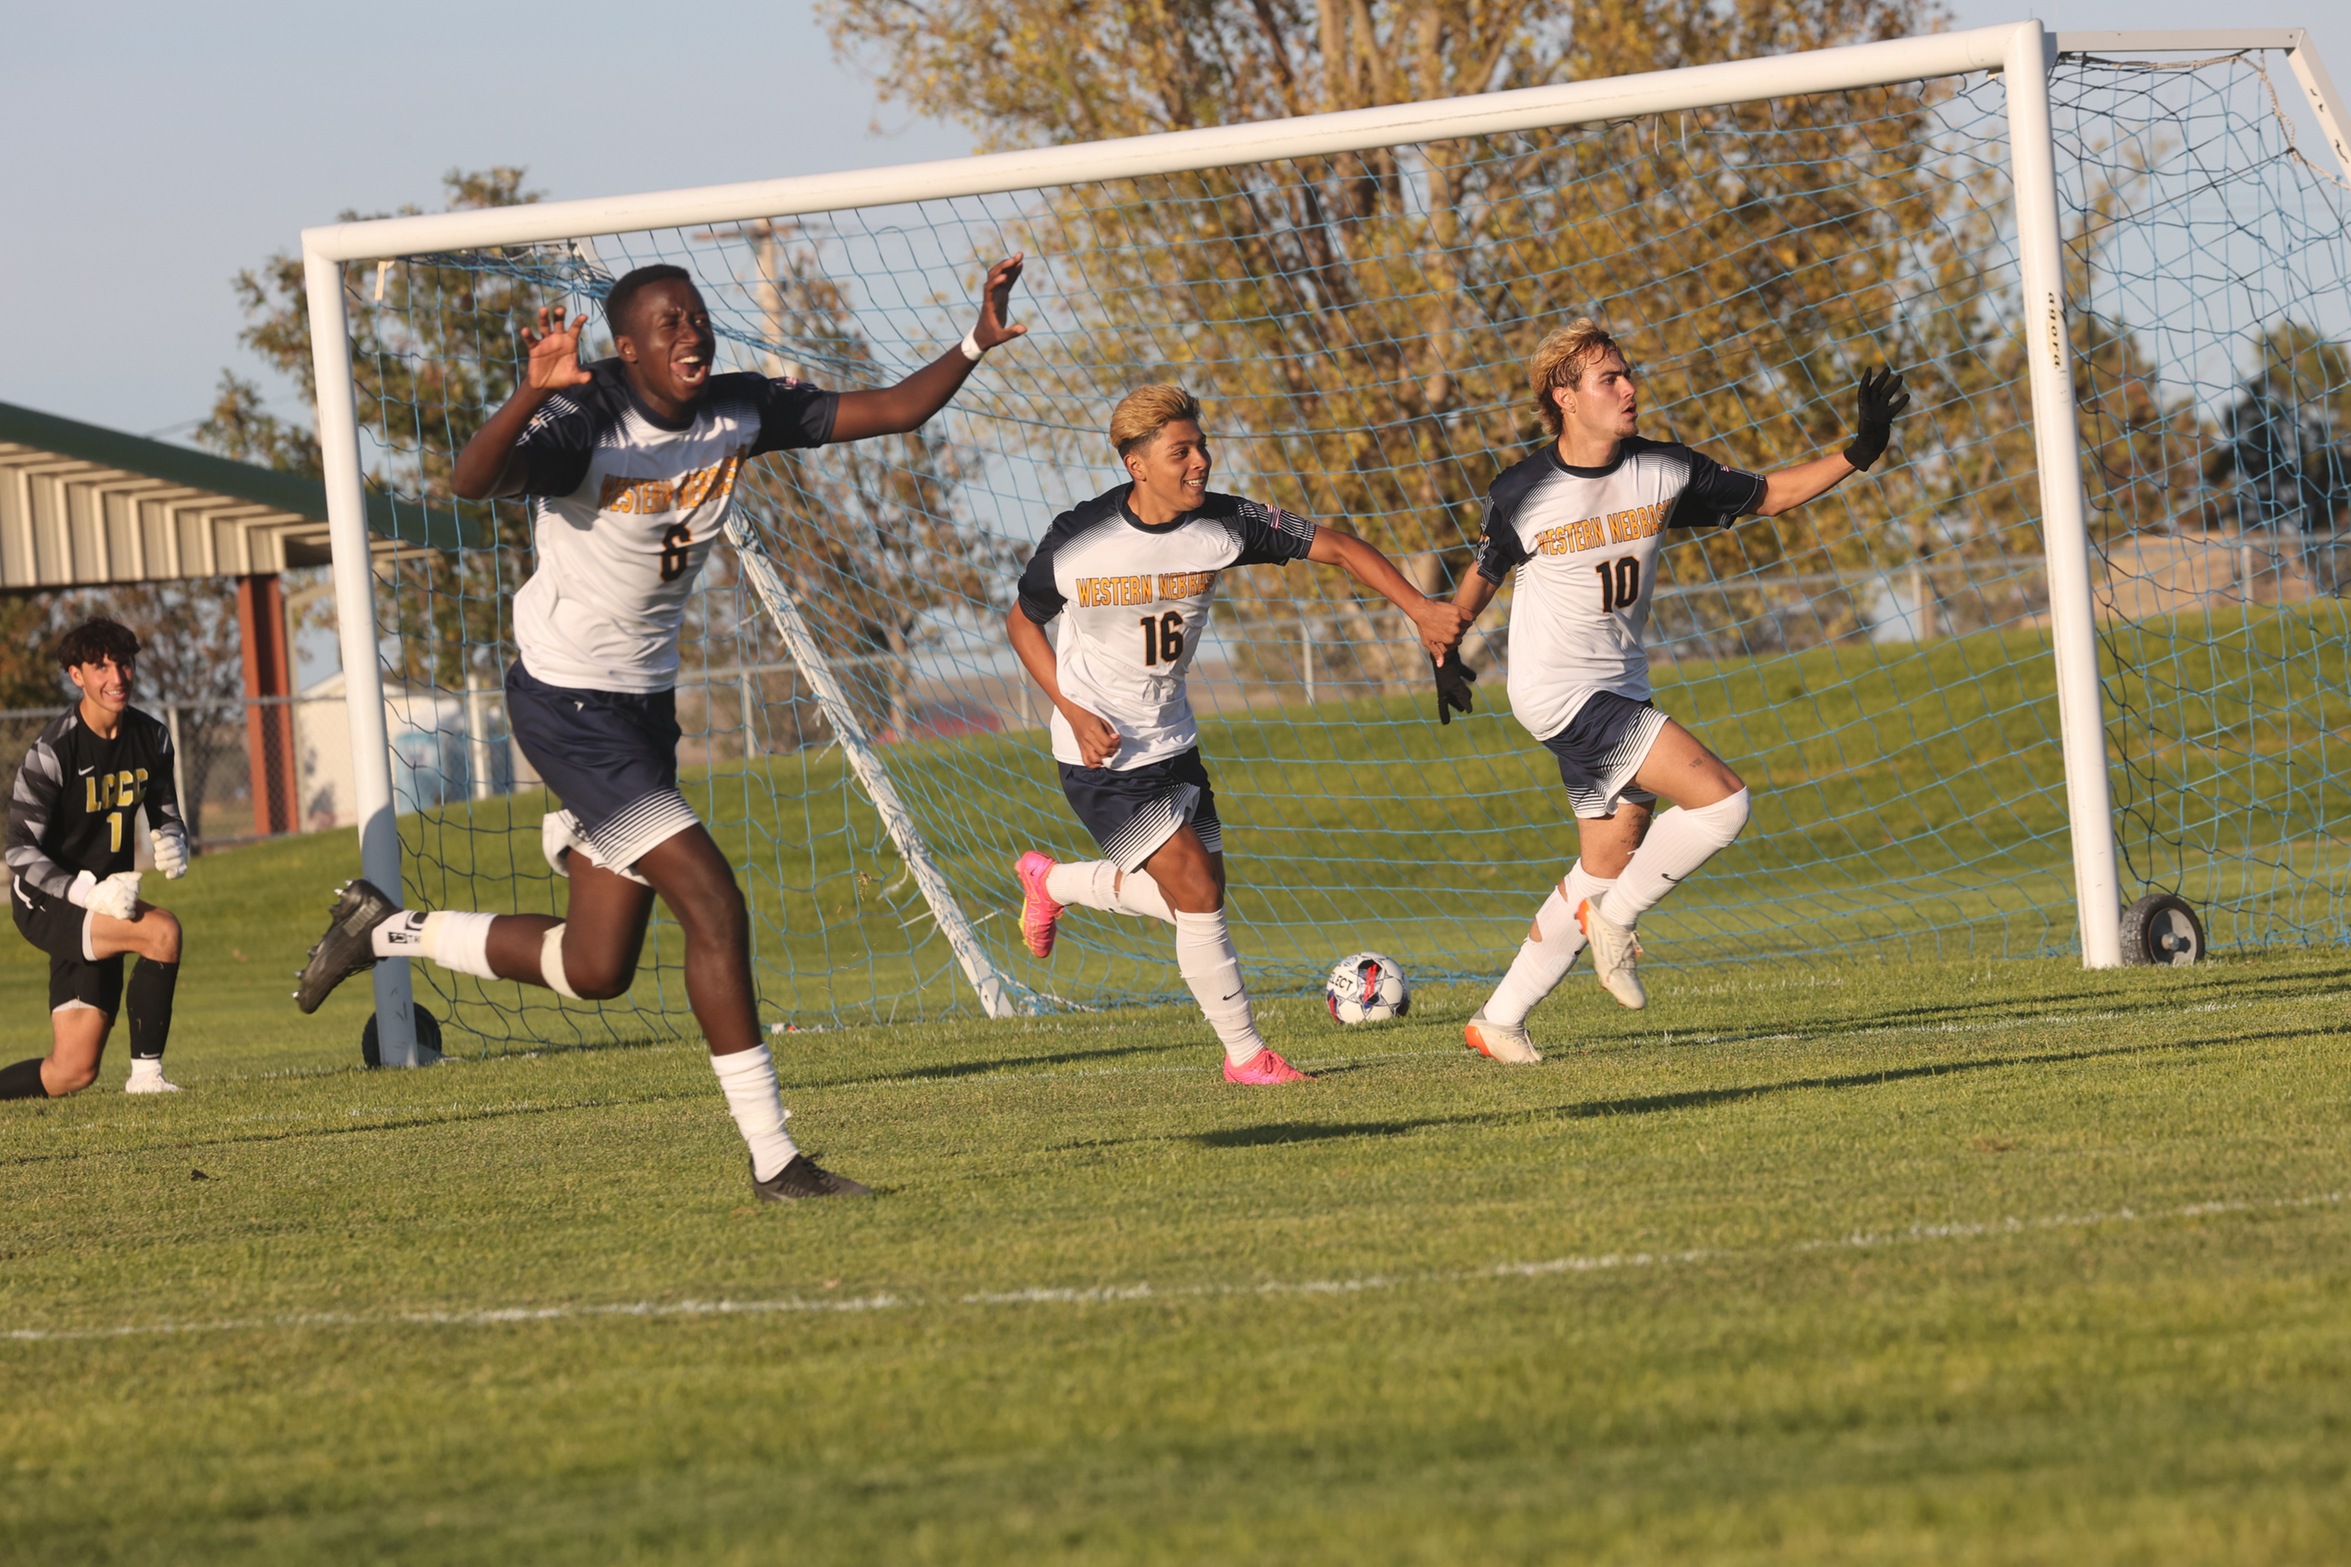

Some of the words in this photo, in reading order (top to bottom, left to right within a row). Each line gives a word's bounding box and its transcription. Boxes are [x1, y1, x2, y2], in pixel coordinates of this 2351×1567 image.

[660, 524, 693, 583] 6
[1535, 517, 1605, 556] WESTERN
[1075, 574, 1153, 608] WESTERN
[1596, 555, 1640, 614] 10
[1140, 610, 1184, 667] 16
[86, 767, 149, 813] LCCC
[106, 811, 123, 853] 1
